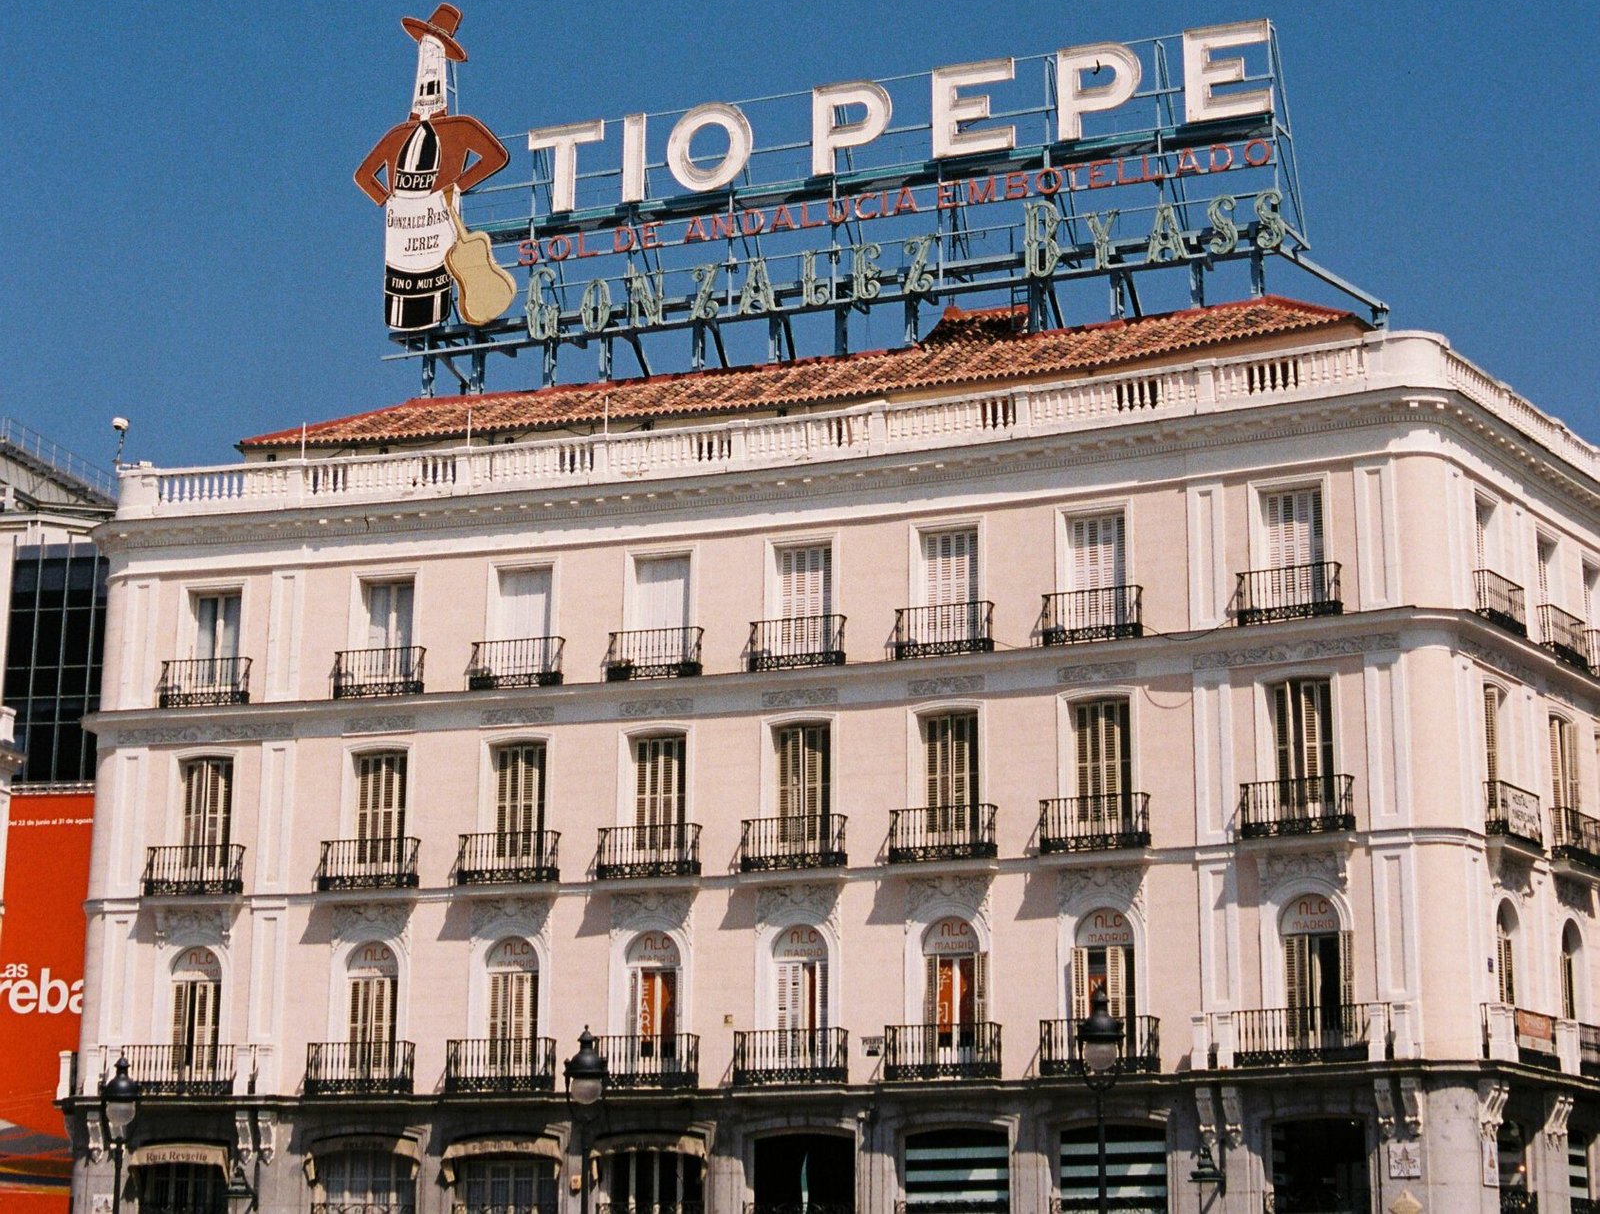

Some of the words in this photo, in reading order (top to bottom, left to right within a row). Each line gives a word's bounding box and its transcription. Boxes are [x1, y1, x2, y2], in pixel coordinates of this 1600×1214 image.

[528, 102, 753, 213] TIO
[812, 18, 1274, 176] PEPE
[518, 231, 598, 266] SOL
[613, 221, 664, 252] DE
[684, 188, 917, 243] ANDALUCIA
[938, 139, 1272, 209] EMBOTELLADO
[405, 234, 440, 252] JEREZ
[525, 233, 936, 340] GONZALEZ
[1023, 188, 1286, 278] BYASS
[392, 277, 412, 289] FINO
[1291, 919, 1335, 929] MADRID
[1086, 932, 1129, 943] MADRID
[933, 940, 975, 951] MADRID
[783, 947, 824, 958] MADRID
